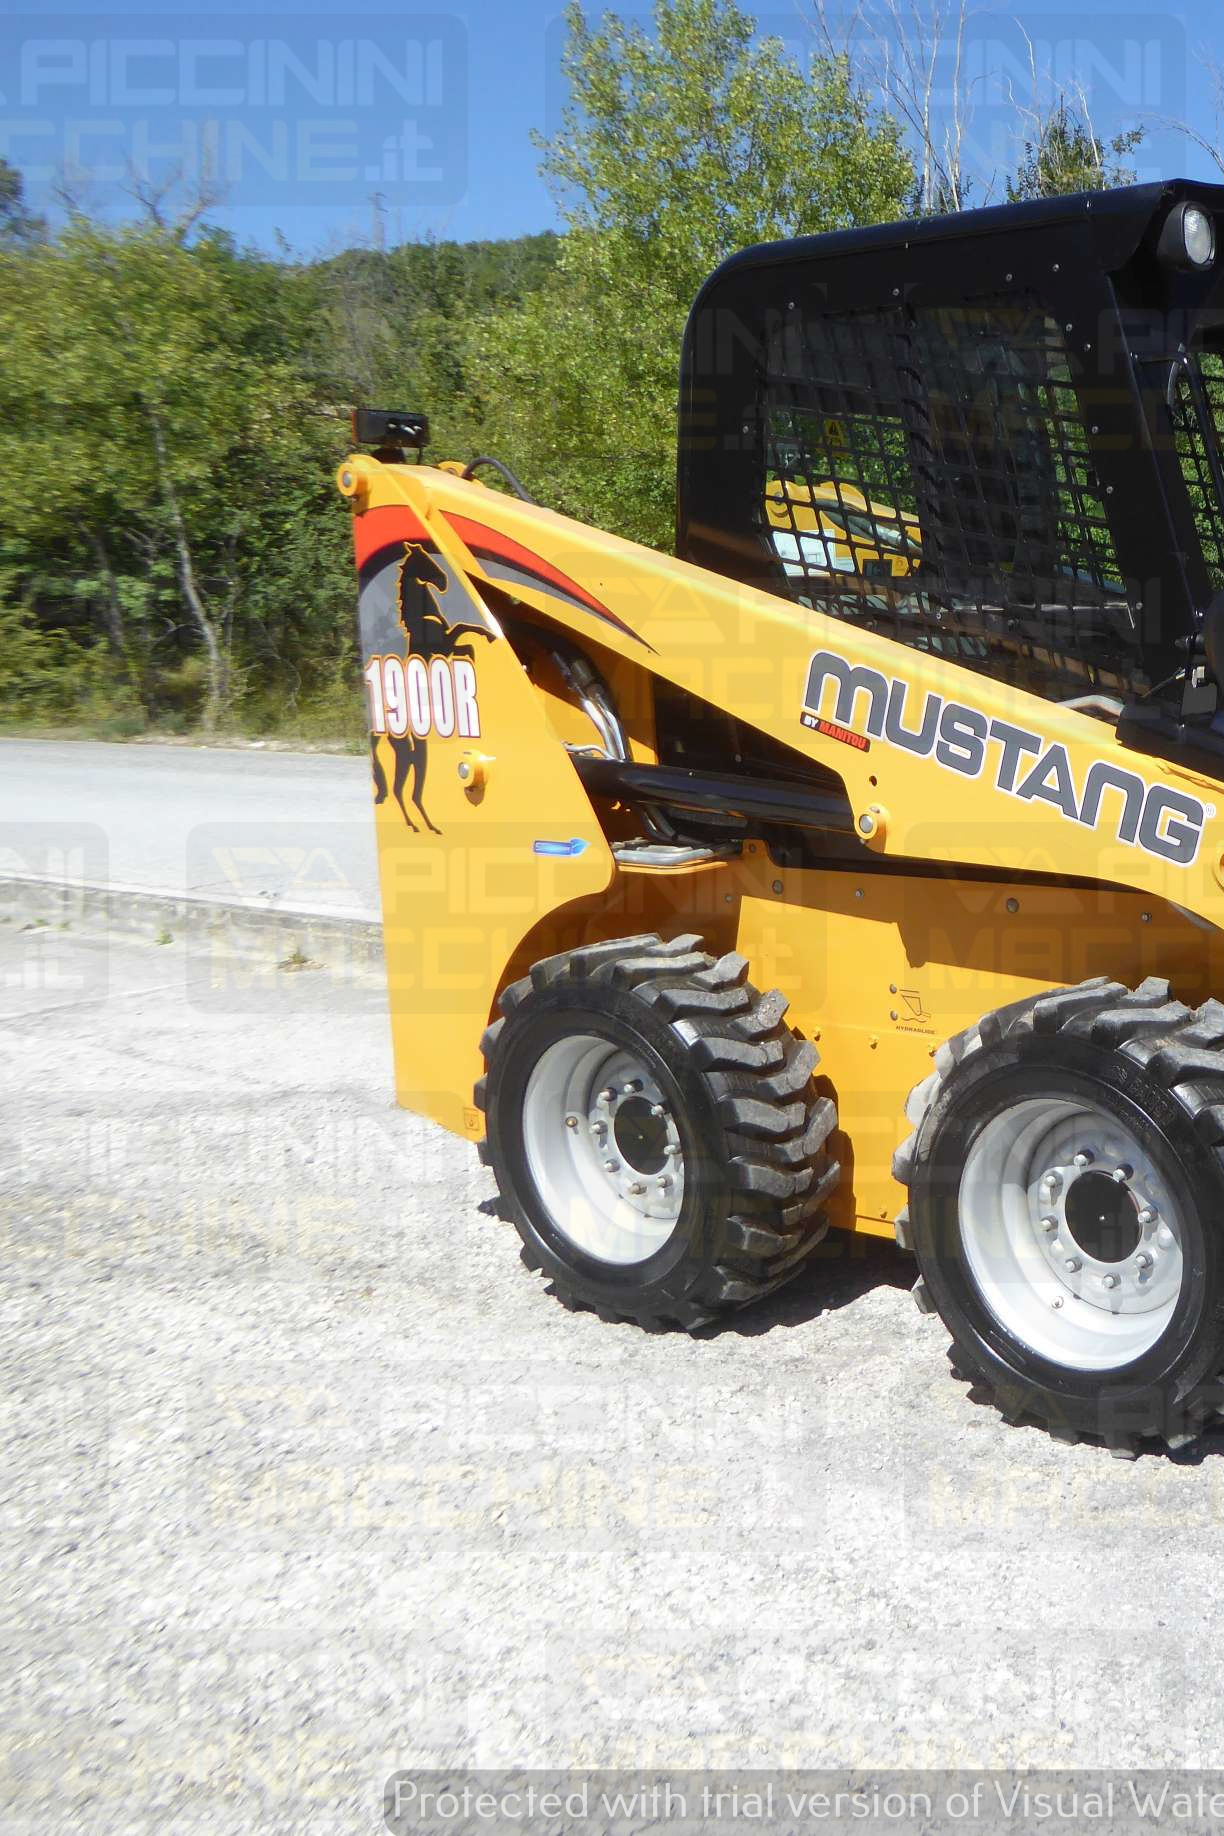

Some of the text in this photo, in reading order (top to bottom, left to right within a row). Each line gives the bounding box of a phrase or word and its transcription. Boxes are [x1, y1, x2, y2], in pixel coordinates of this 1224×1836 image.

[363, 655, 480, 738] 1900R
[803, 714, 867, 749] BY MANITOU
[803, 651, 1204, 864] MUSTANG
